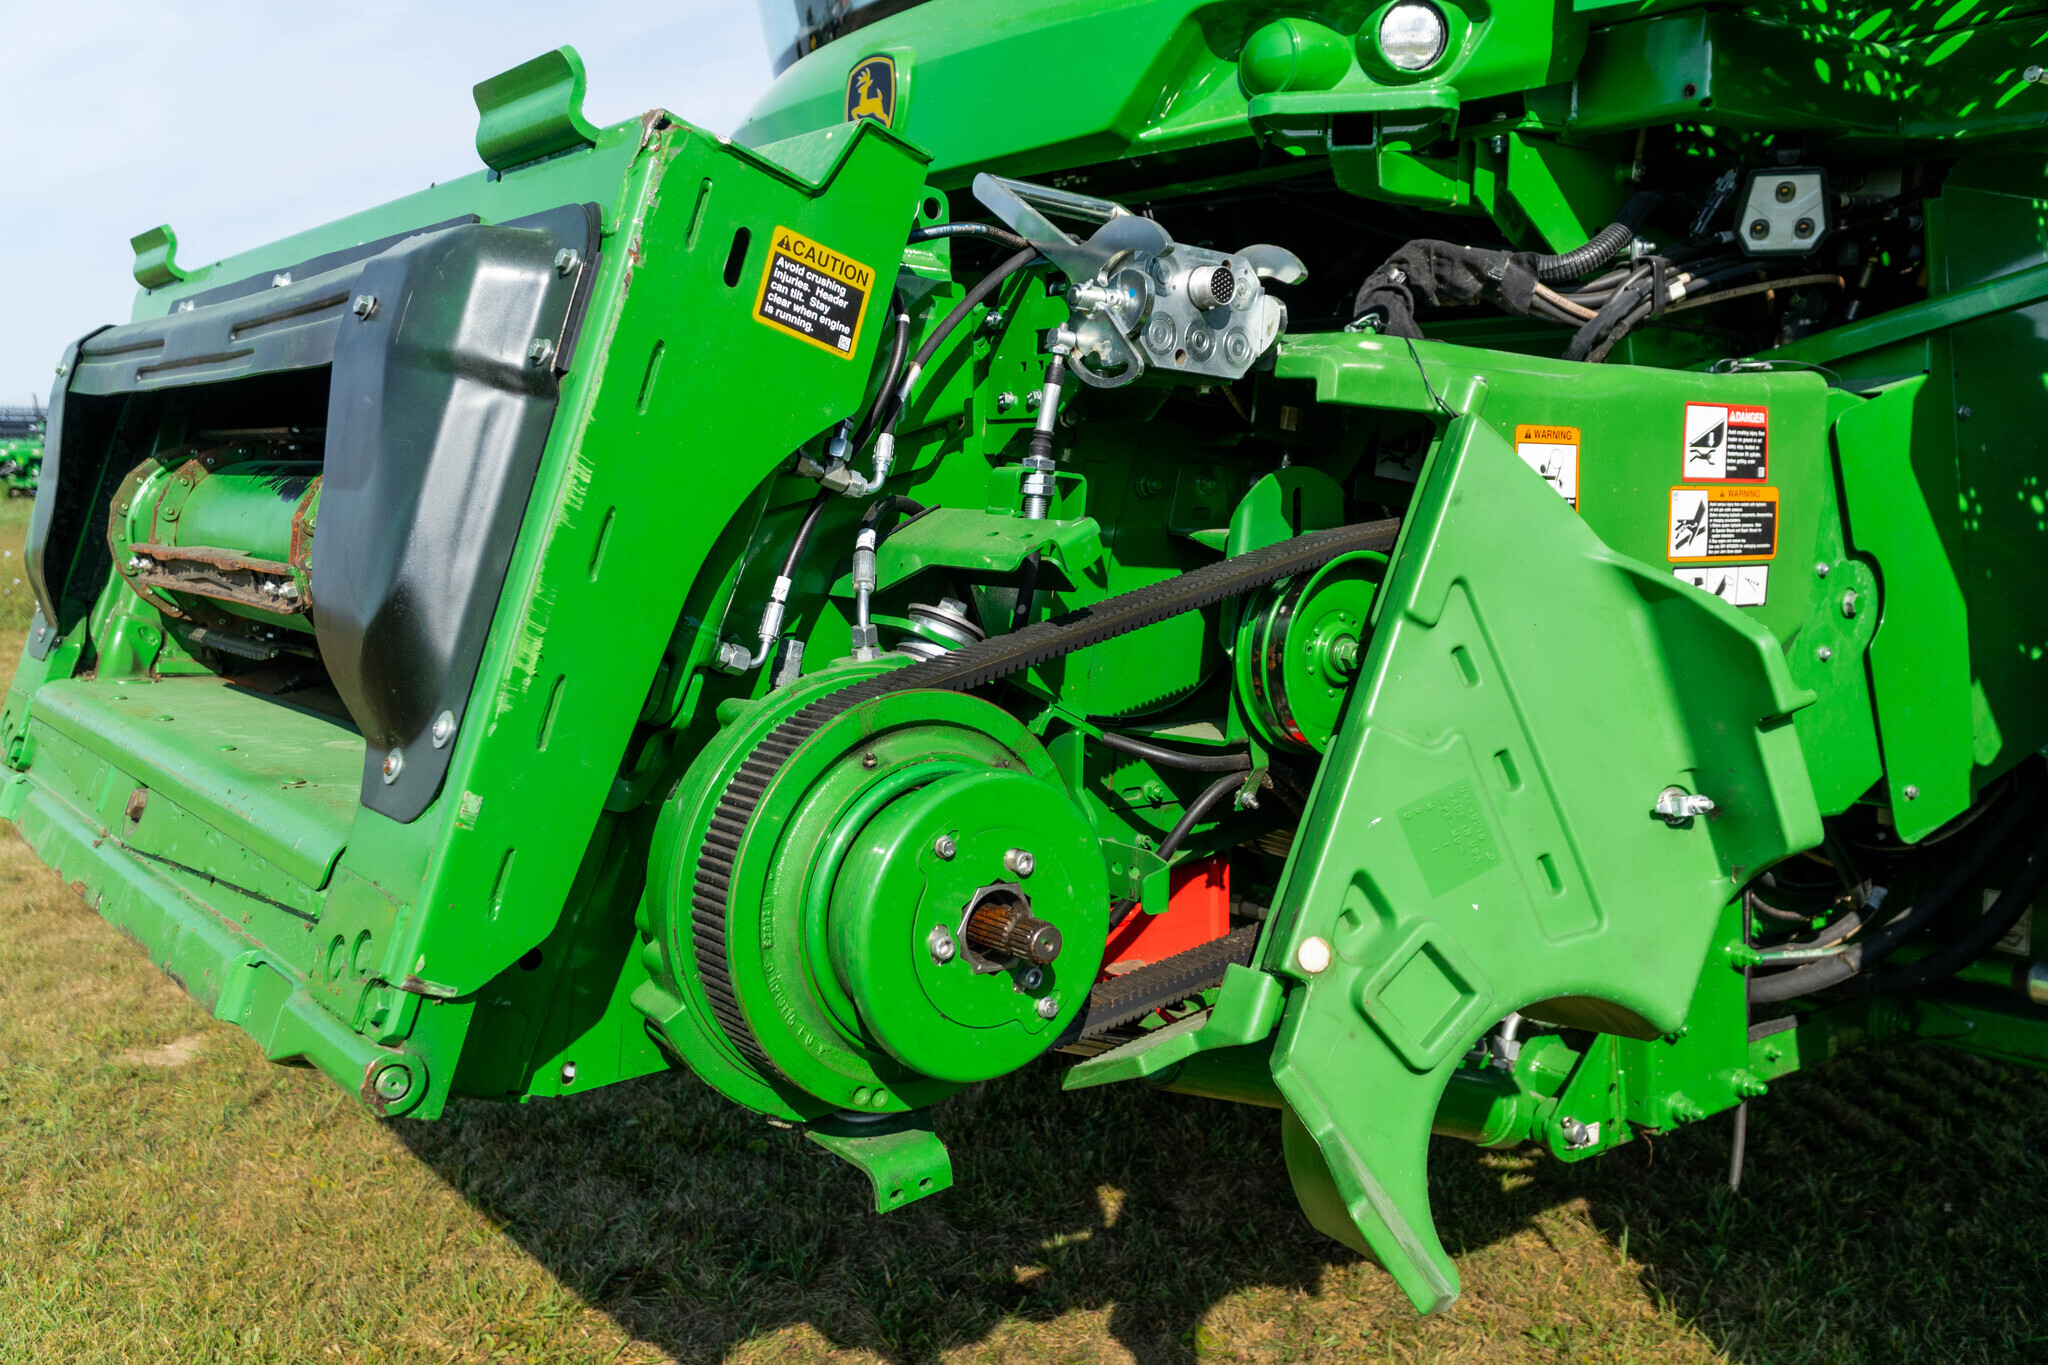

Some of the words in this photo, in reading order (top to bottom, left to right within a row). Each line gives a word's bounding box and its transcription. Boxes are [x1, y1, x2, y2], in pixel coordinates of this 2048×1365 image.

[776, 256, 805, 277] Avoid
[805, 271, 847, 297] crushing
[792, 240, 869, 287] CAUTION
[770, 281, 788, 295] can
[790, 288, 805, 303] tilt.
[809, 296, 831, 315] Stay
[773, 267, 810, 293] injuries.
[815, 286, 849, 309] Header
[764, 302, 774, 314] is
[775, 308, 814, 332] running.
[767, 292, 792, 309] clear
[793, 303, 818, 321] when
[819, 314, 850, 334] engine
[1534, 429, 1572, 440] WARNING
[1735, 411, 1765, 424] DANGER
[1727, 489, 1761, 498] WARNING
